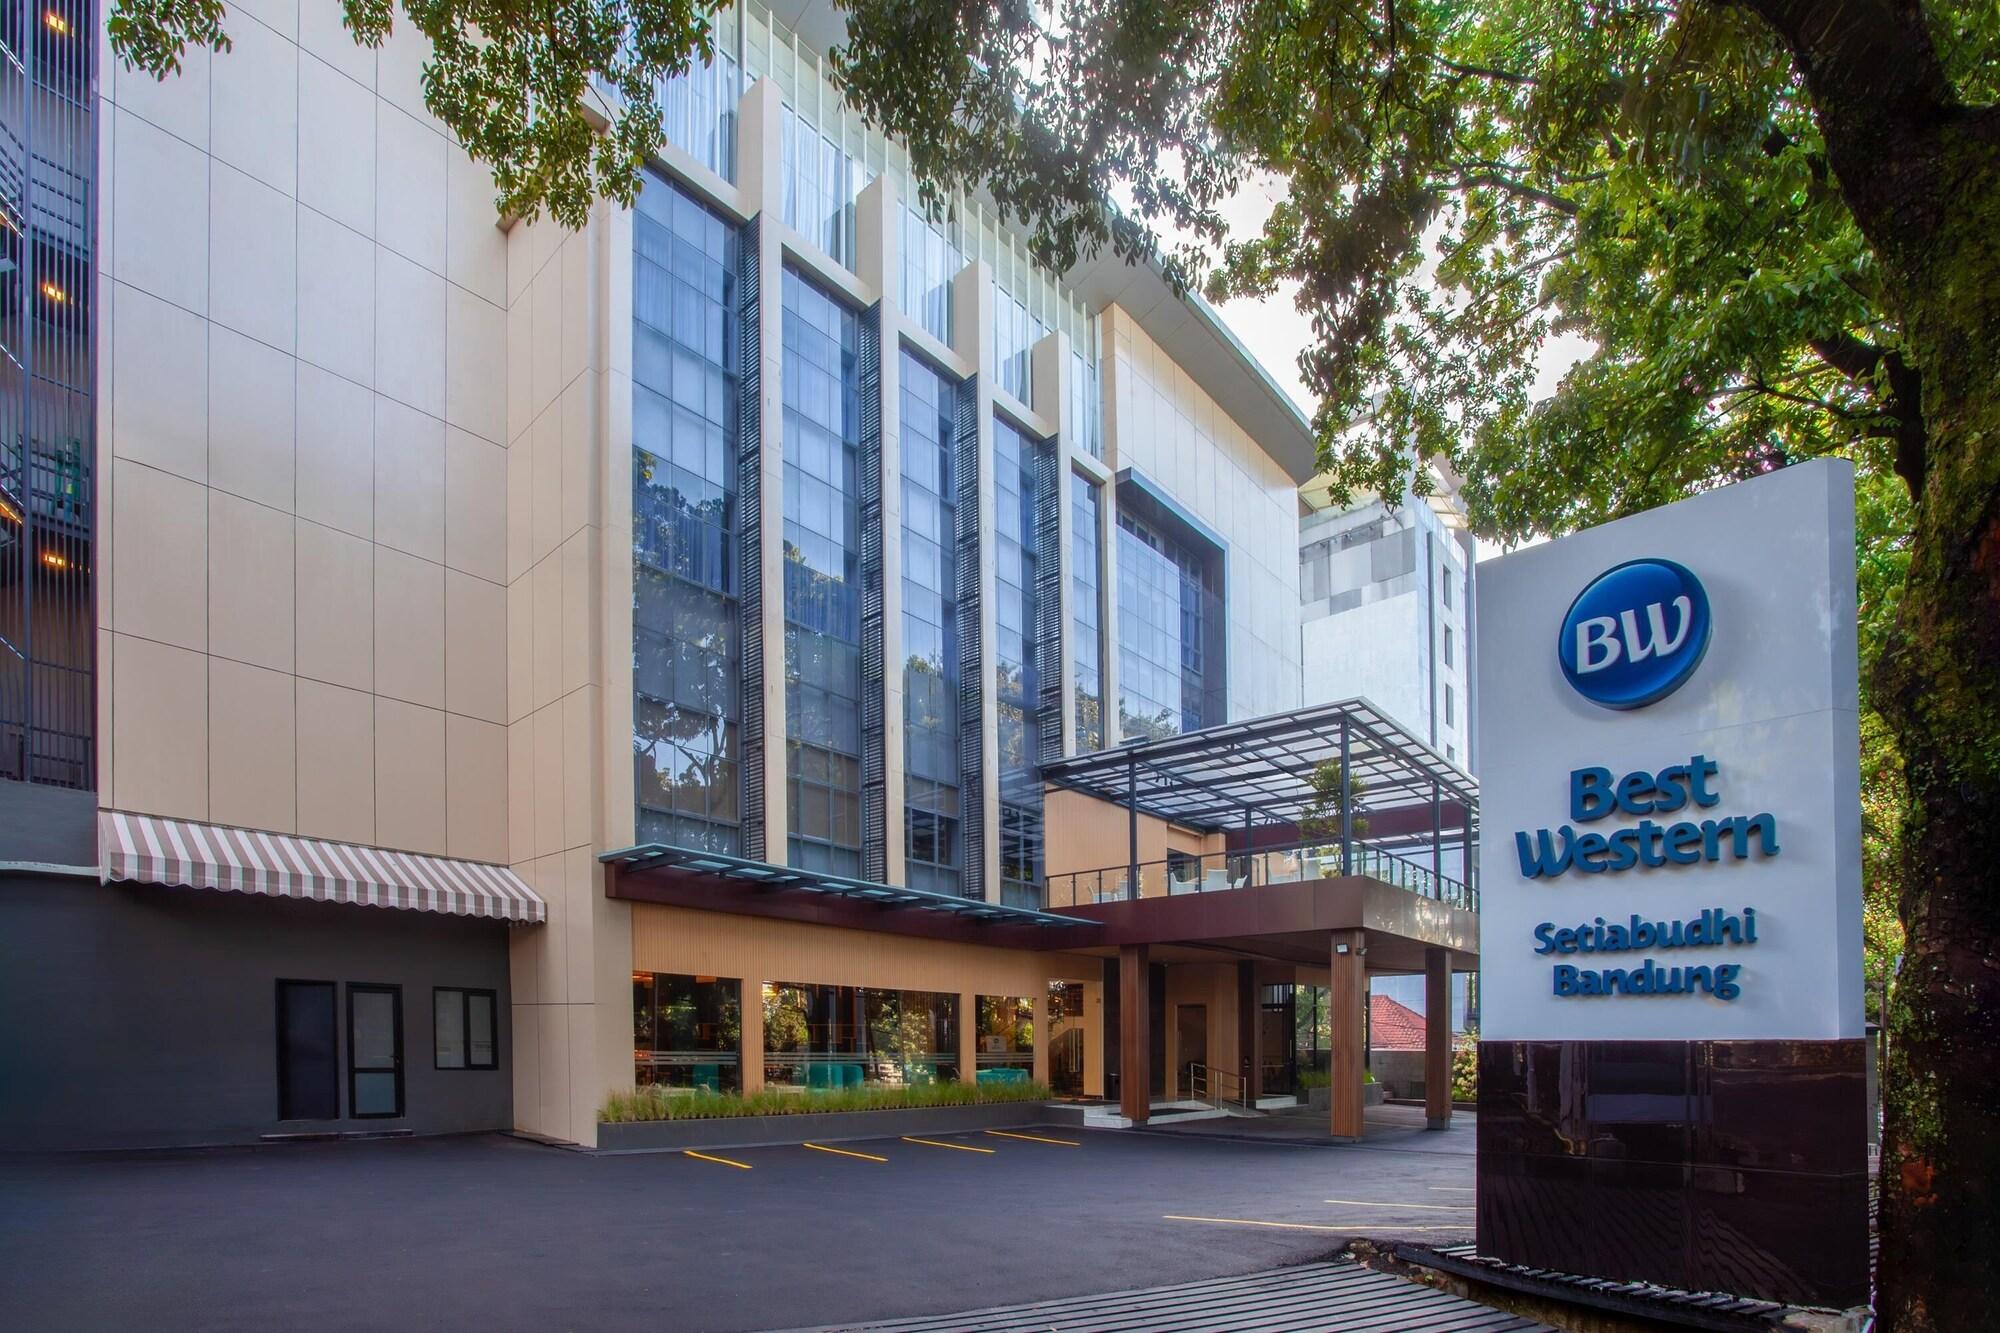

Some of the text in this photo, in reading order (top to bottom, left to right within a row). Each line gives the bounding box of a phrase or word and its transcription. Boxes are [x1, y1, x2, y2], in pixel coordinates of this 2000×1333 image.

[1575, 595, 1692, 675] BW
[1570, 755, 1720, 822] Best
[1515, 812, 1779, 879] Western
[1533, 907, 1757, 955] Setiabudhi
[1553, 959, 1741, 1000] Bandung
